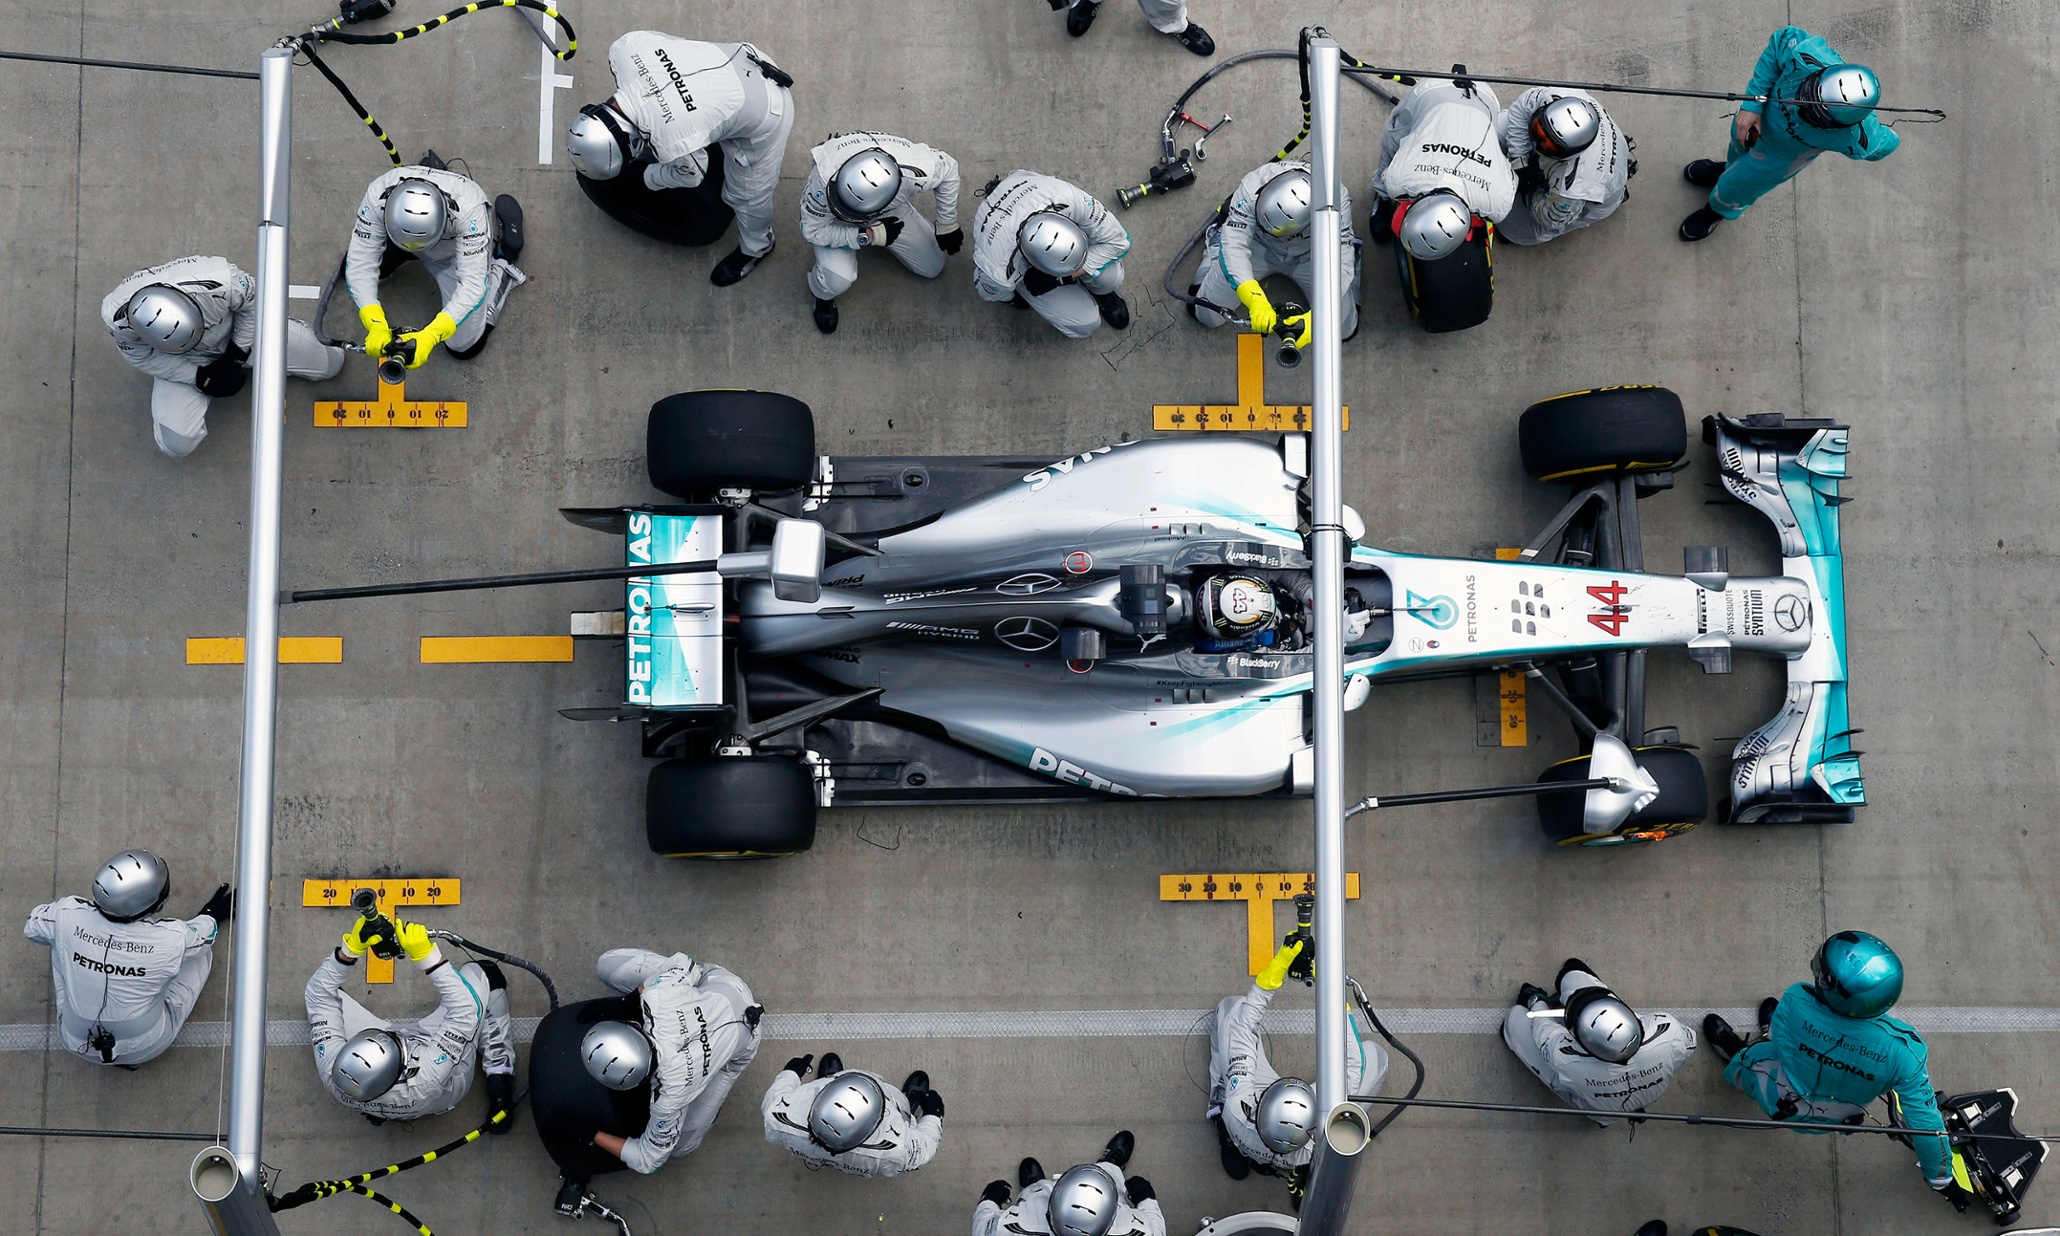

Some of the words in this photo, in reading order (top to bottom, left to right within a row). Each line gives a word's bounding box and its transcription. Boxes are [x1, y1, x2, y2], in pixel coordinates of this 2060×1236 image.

[631, 52, 675, 124] Mercedes-Benz
[654, 48, 697, 113] PETRONAS
[1421, 143, 1492, 168] PETRONAS
[1413, 164, 1492, 192] Mercedes-Benz
[333, 409, 347, 419] 20
[358, 409, 371, 419] 10
[387, 409, 395, 419] 0
[409, 409, 422, 419] 10
[435, 409, 449, 419] 20
[1248, 413, 1256, 423] 0
[1226, 550, 1268, 564] BlackBerry
[1233, 588, 1247, 614] 44
[1465, 574, 1477, 643] PETRONAS
[1586, 580, 1629, 637] 44
[1696, 588, 1707, 634] PIRELLI
[1741, 589, 1750, 636] PETRONAS
[1750, 589, 1764, 636] SYNTIUM
[918, 630, 980, 640] HYBRID
[1239, 658, 1280, 670] BlackBerry
[323, 889, 337, 898] 20
[377, 888, 386, 898] 0
[402, 888, 415, 897] 10
[427, 887, 441, 897] 20
[1178, 882, 1192, 893] 30
[1203, 882, 1217, 893] 20
[1229, 882, 1242, 893] 10
[1279, 882, 1291, 892] 10
[73, 925, 154, 954] Mercedes-Benz
[72, 952, 146, 977] PETRONAS
[676, 1008, 694, 1087] Mercedes-Benz
[693, 1005, 712, 1078] PETRONAS
[1801, 1020, 1888, 1064] Mercedes-Benz
[1585, 1062, 1664, 1088] Mercedes-Benz
[1798, 1042, 1876, 1082] PETRONAS
[1593, 1076, 1665, 1099] PETRONAS
